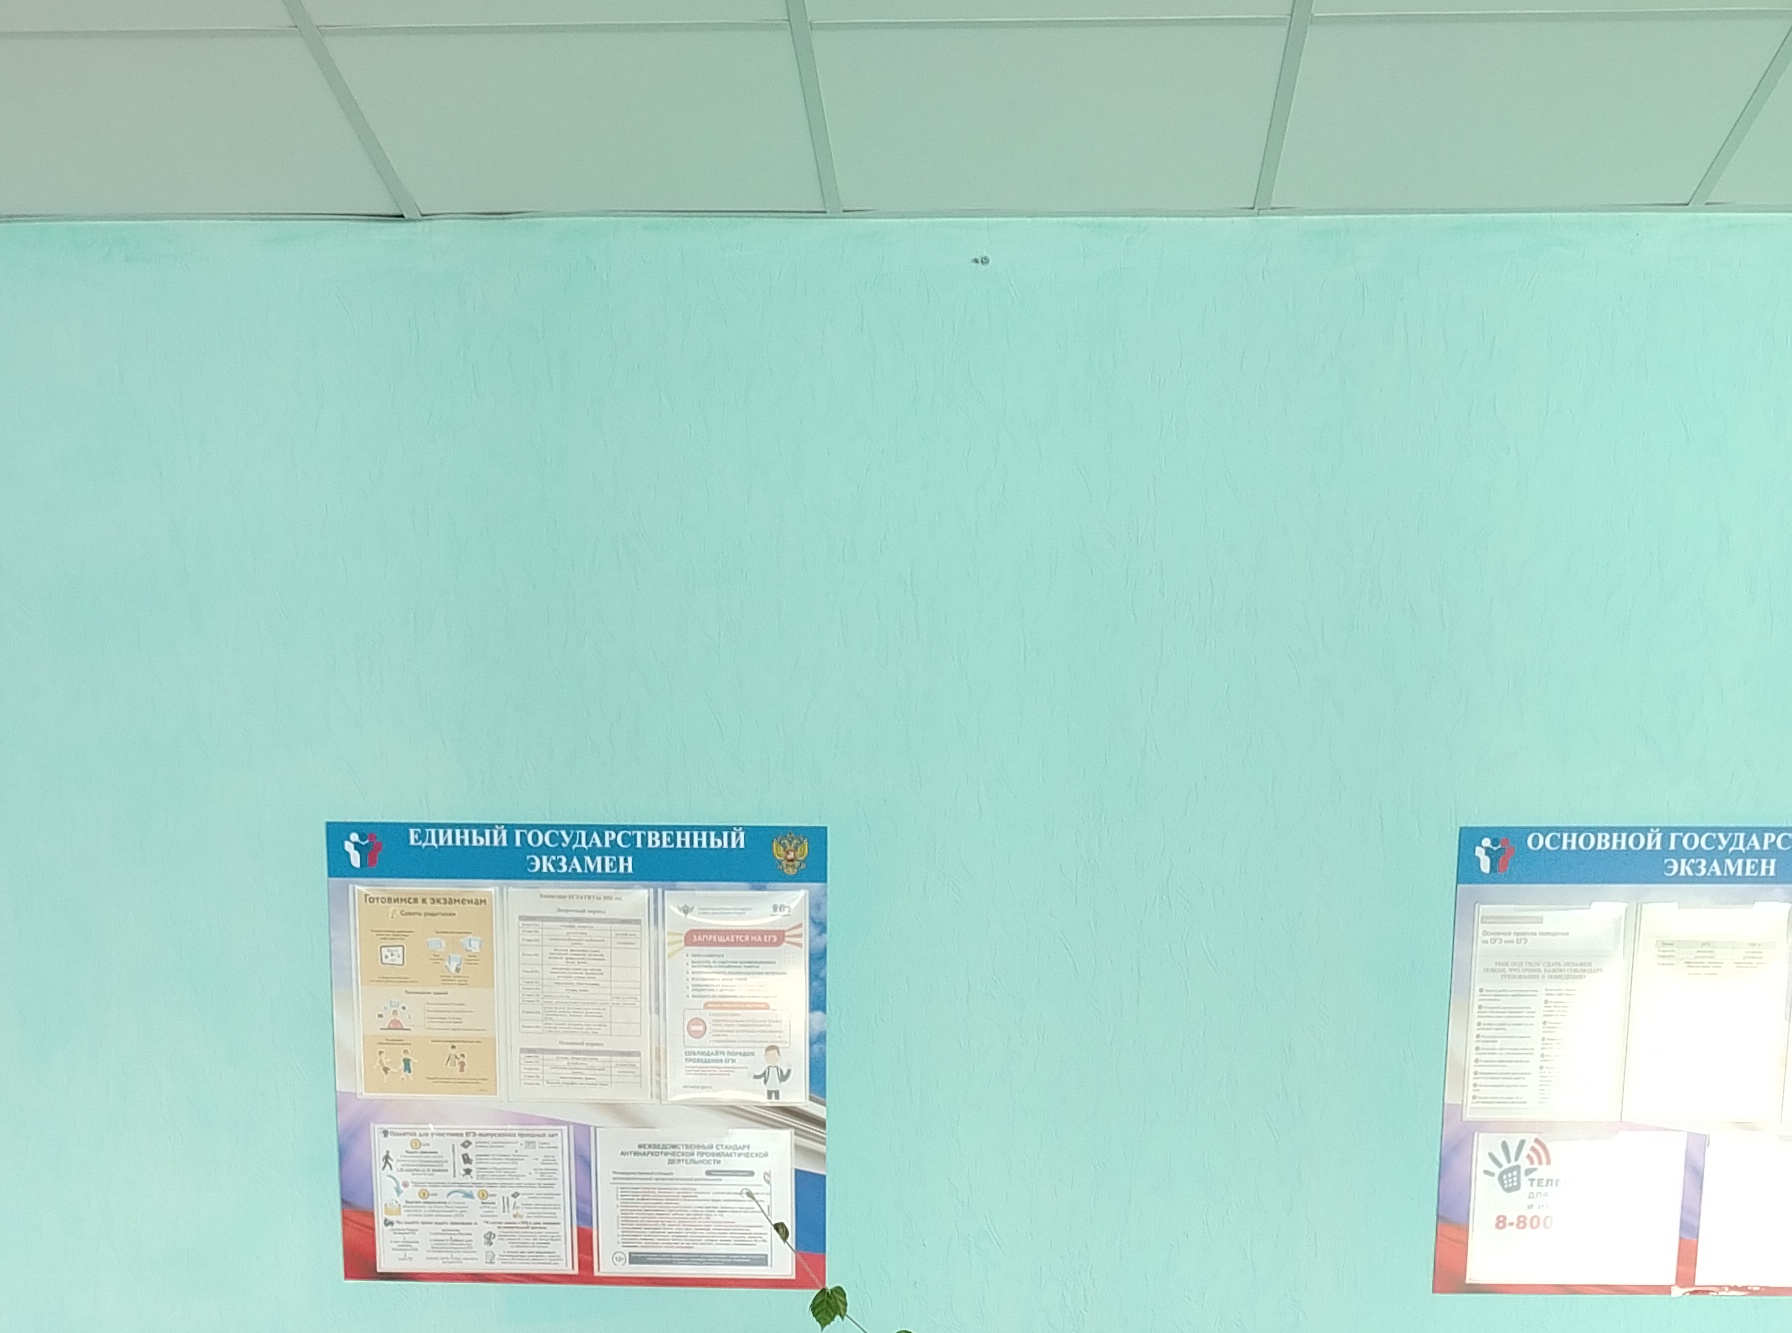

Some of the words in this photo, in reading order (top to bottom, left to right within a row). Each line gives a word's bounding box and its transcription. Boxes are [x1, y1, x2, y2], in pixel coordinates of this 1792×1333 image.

[408, 825, 507, 849] ЕДИНЫЙ
[514, 827, 745, 851] ГОСУДАРСТВЕННЫЙ
[1526, 828, 1662, 850] ОСНОВНОЙ
[526, 855, 633, 874] ЭКЗАМЕН
[1663, 859, 1777, 877] ЭКЗАМЕН
[364, 894, 419, 906] Готовимся
[421, 897, 428, 905] к
[430, 897, 487, 907] экзаменам
[692, 934, 750, 944] ЗАПРЕЩАЕТСЯ
[751, 934, 763, 943] НА
[764, 934, 778, 944] ЕГЭ
